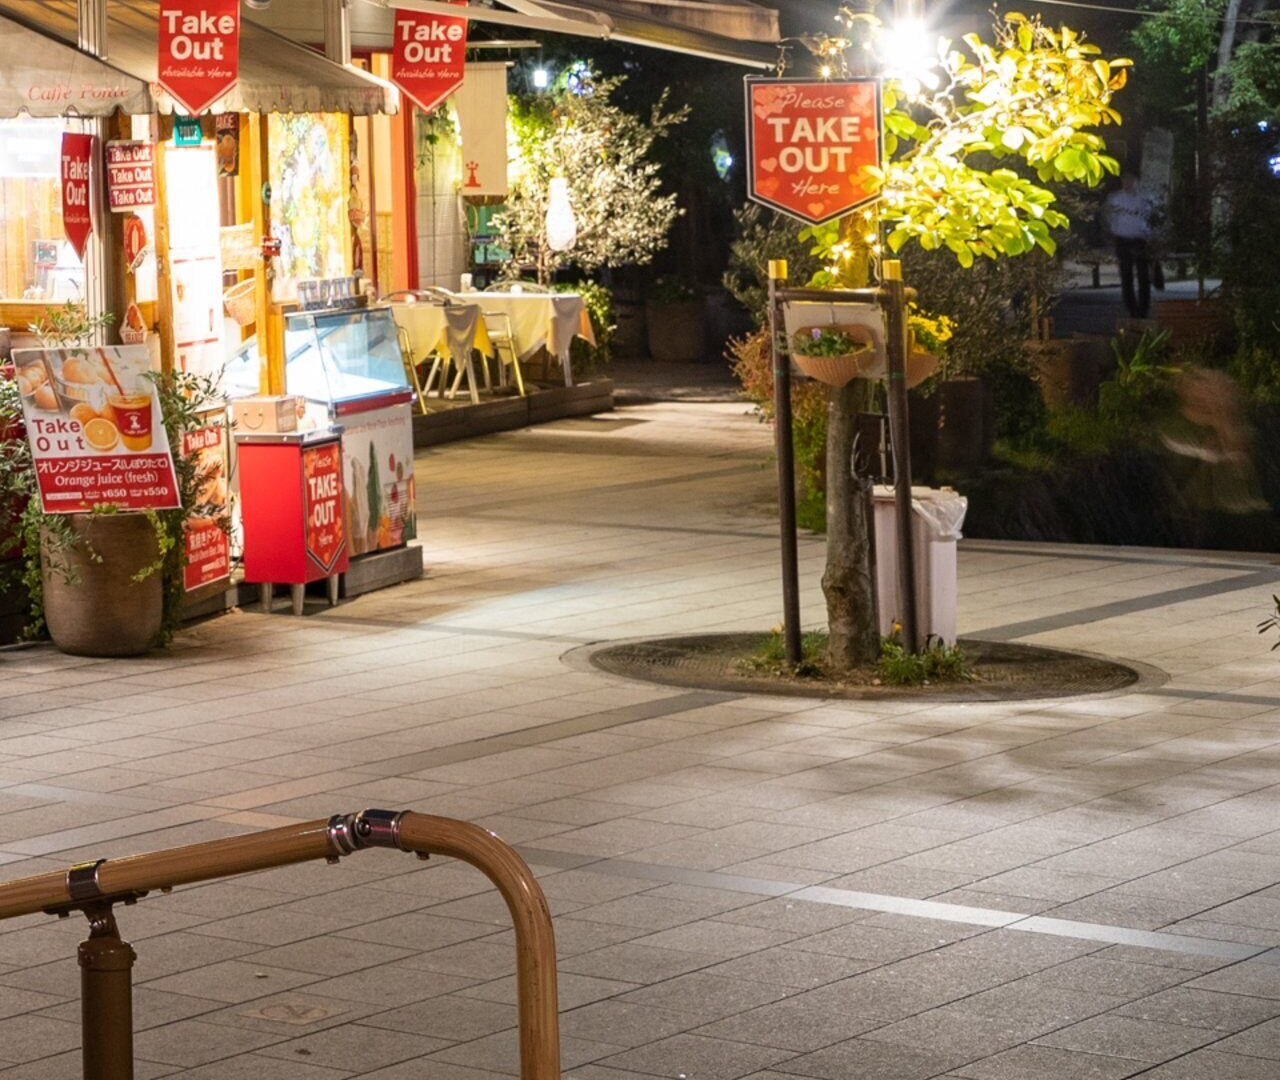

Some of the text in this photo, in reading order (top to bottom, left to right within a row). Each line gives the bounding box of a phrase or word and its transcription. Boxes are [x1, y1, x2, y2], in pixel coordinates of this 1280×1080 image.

[163, 10, 236, 35] Take
[397, 20, 463, 42] Take
[170, 35, 224, 60] Out
[404, 42, 453, 63] Out
[162, 65, 233, 78] Available Here
[437, 68, 459, 79] Here
[782, 92, 845, 109] Please
[767, 117, 861, 143] TAKE
[110, 146, 150, 162] Take Out
[778, 146, 852, 173] OUT
[62, 155, 89, 181] Take
[111, 167, 152, 183] Take Out
[66, 182, 87, 206] Out
[113, 188, 153, 204] Take Out
[792, 176, 840, 197] Here
[32, 419, 81, 434] Take
[36, 436, 85, 452] Out
[187, 429, 219, 451] Take Out
[55, 471, 159, 487] Orange juice (fresh)
[309, 473, 338, 500] TAKE
[313, 501, 336, 527] OUT
[317, 529, 333, 548] Here
